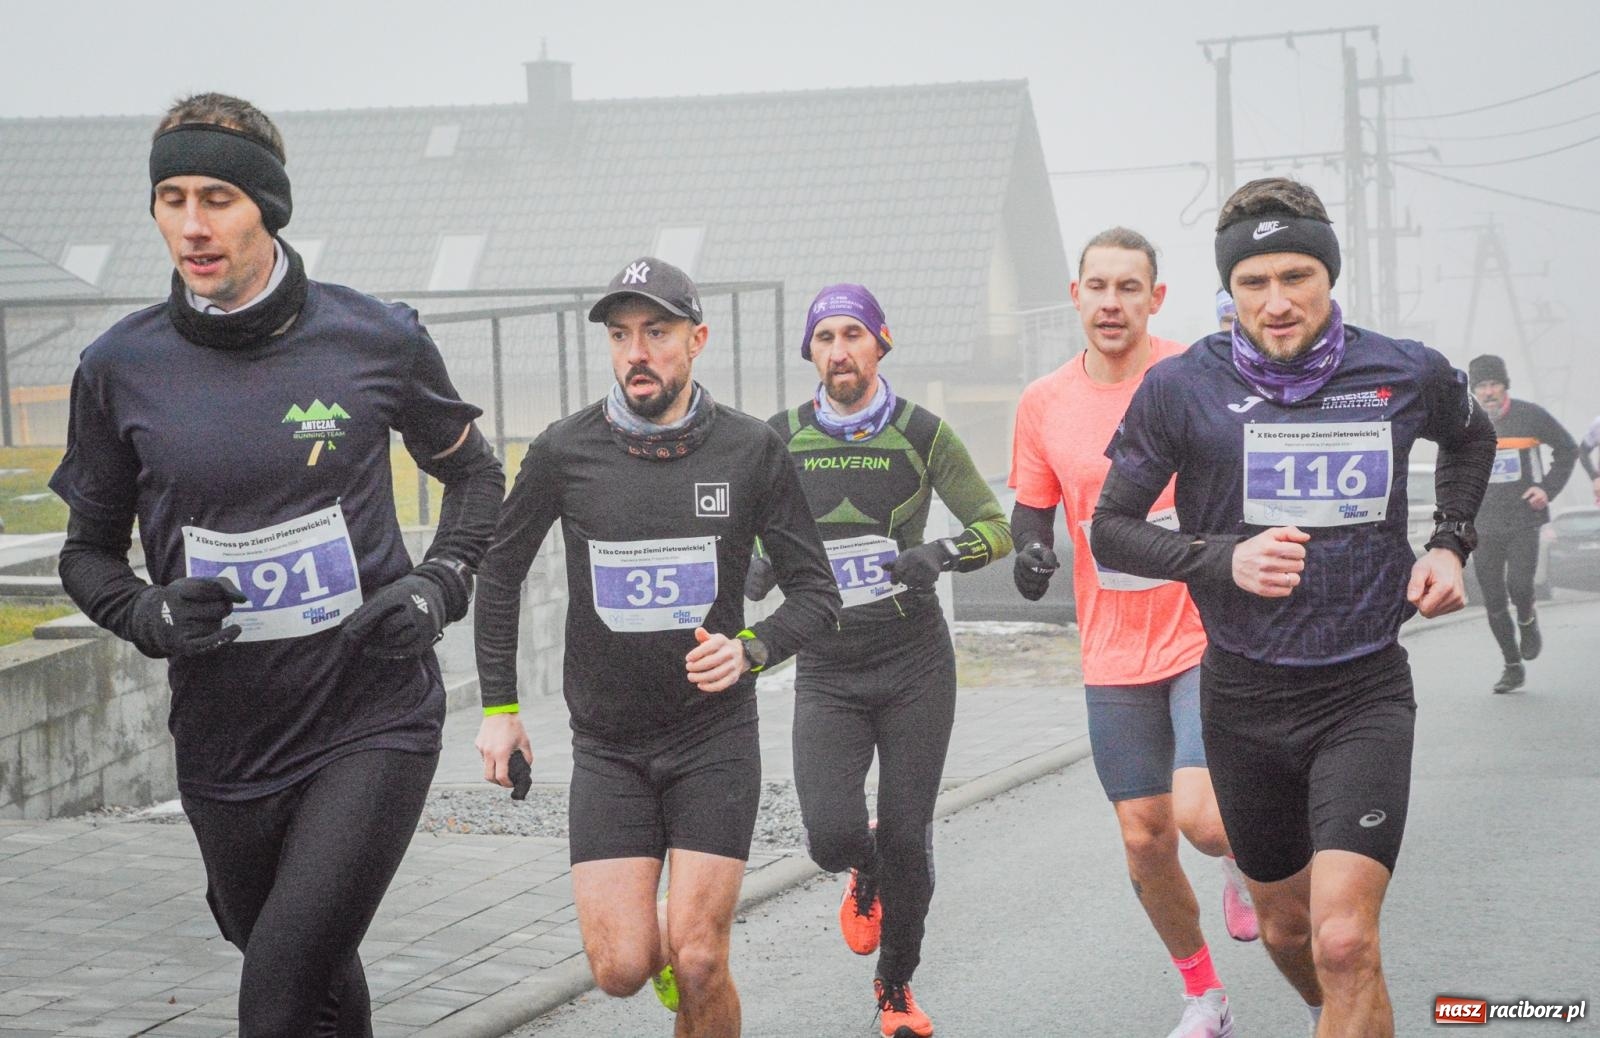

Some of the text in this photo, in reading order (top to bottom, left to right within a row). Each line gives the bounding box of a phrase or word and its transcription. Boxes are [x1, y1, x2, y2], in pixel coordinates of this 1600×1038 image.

[1258, 220, 1280, 232] NIKE
[622, 261, 650, 284] NY
[1321, 397, 1389, 409] MARATHON
[301, 419, 336, 430] ANTCZAK
[1333, 430, 1379, 438] Pietrowickiej
[293, 431, 325, 439] RUNNING
[804, 456, 890, 471] WOLVERIN
[1274, 454, 1367, 497] 116
[700, 488, 725, 511] all
[215, 540, 237, 548] Cross
[238, 541, 250, 549] po
[251, 534, 275, 546] Ziemi
[276, 518, 331, 540] Pietrowickiej
[662, 544, 706, 553] Pietrowickiej
[216, 551, 330, 608] 191
[830, 555, 884, 588] 15
[626, 567, 680, 607] 35
